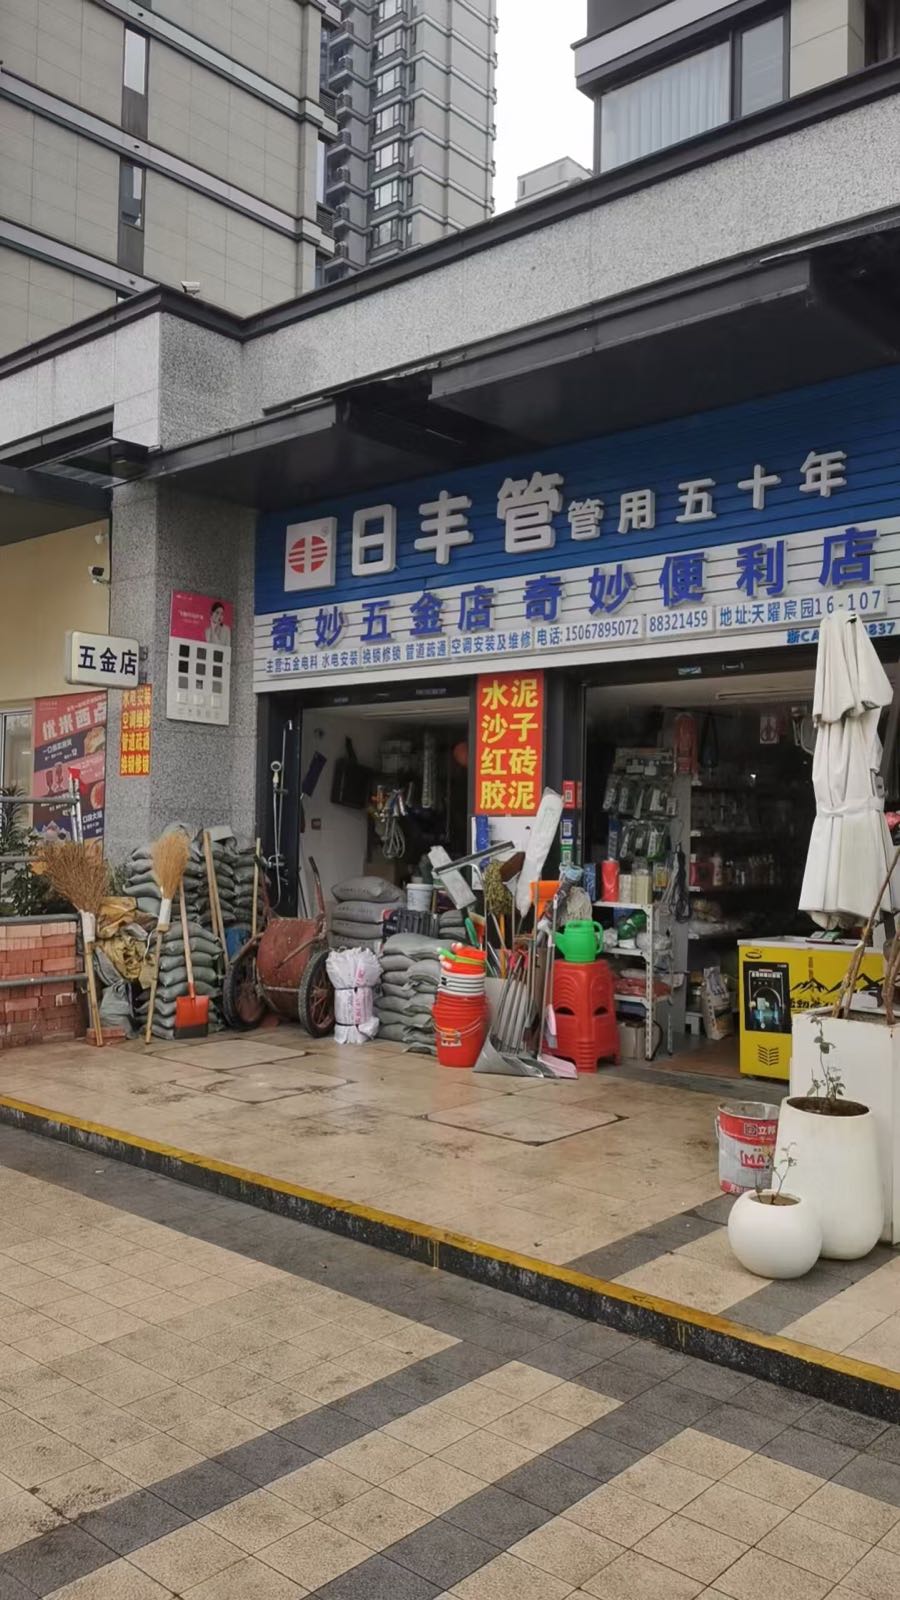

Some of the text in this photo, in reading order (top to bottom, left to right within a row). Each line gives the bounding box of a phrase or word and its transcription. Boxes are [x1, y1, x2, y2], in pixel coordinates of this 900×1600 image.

[352, 450, 847, 577] 日丰管 管用五十年
[321, 650, 359, 669] 水电安装
[451, 631, 531, 655] 空调安装及维修
[650, 610, 708, 632] 88321459
[78, 645, 137, 676] 五金店
[482, 679, 538, 710] 水泥
[481, 713, 538, 744] 沙子
[480, 745, 537, 776] 红砖
[480, 780, 535, 810] 胶泥
